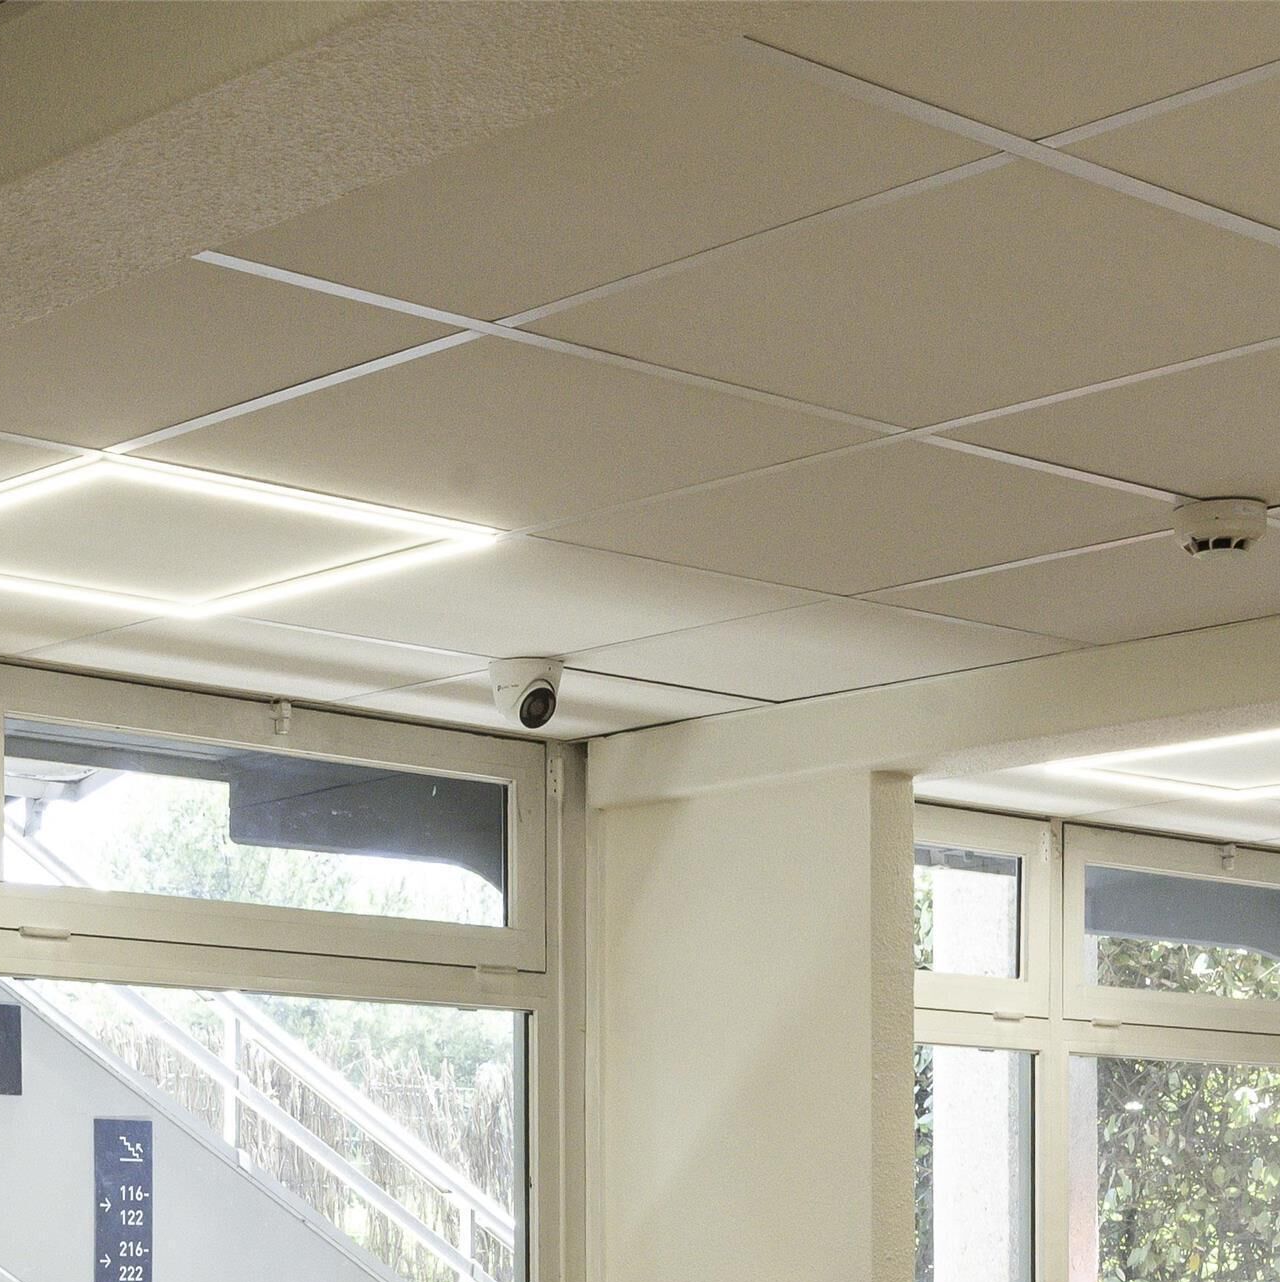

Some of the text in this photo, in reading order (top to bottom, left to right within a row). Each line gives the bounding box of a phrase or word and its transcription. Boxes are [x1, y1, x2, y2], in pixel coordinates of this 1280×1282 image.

[120, 1185, 150, 1201] 116-
[120, 1209, 144, 1225] 122
[119, 1241, 150, 1257] 216-
[119, 1265, 144, 1281] 222
